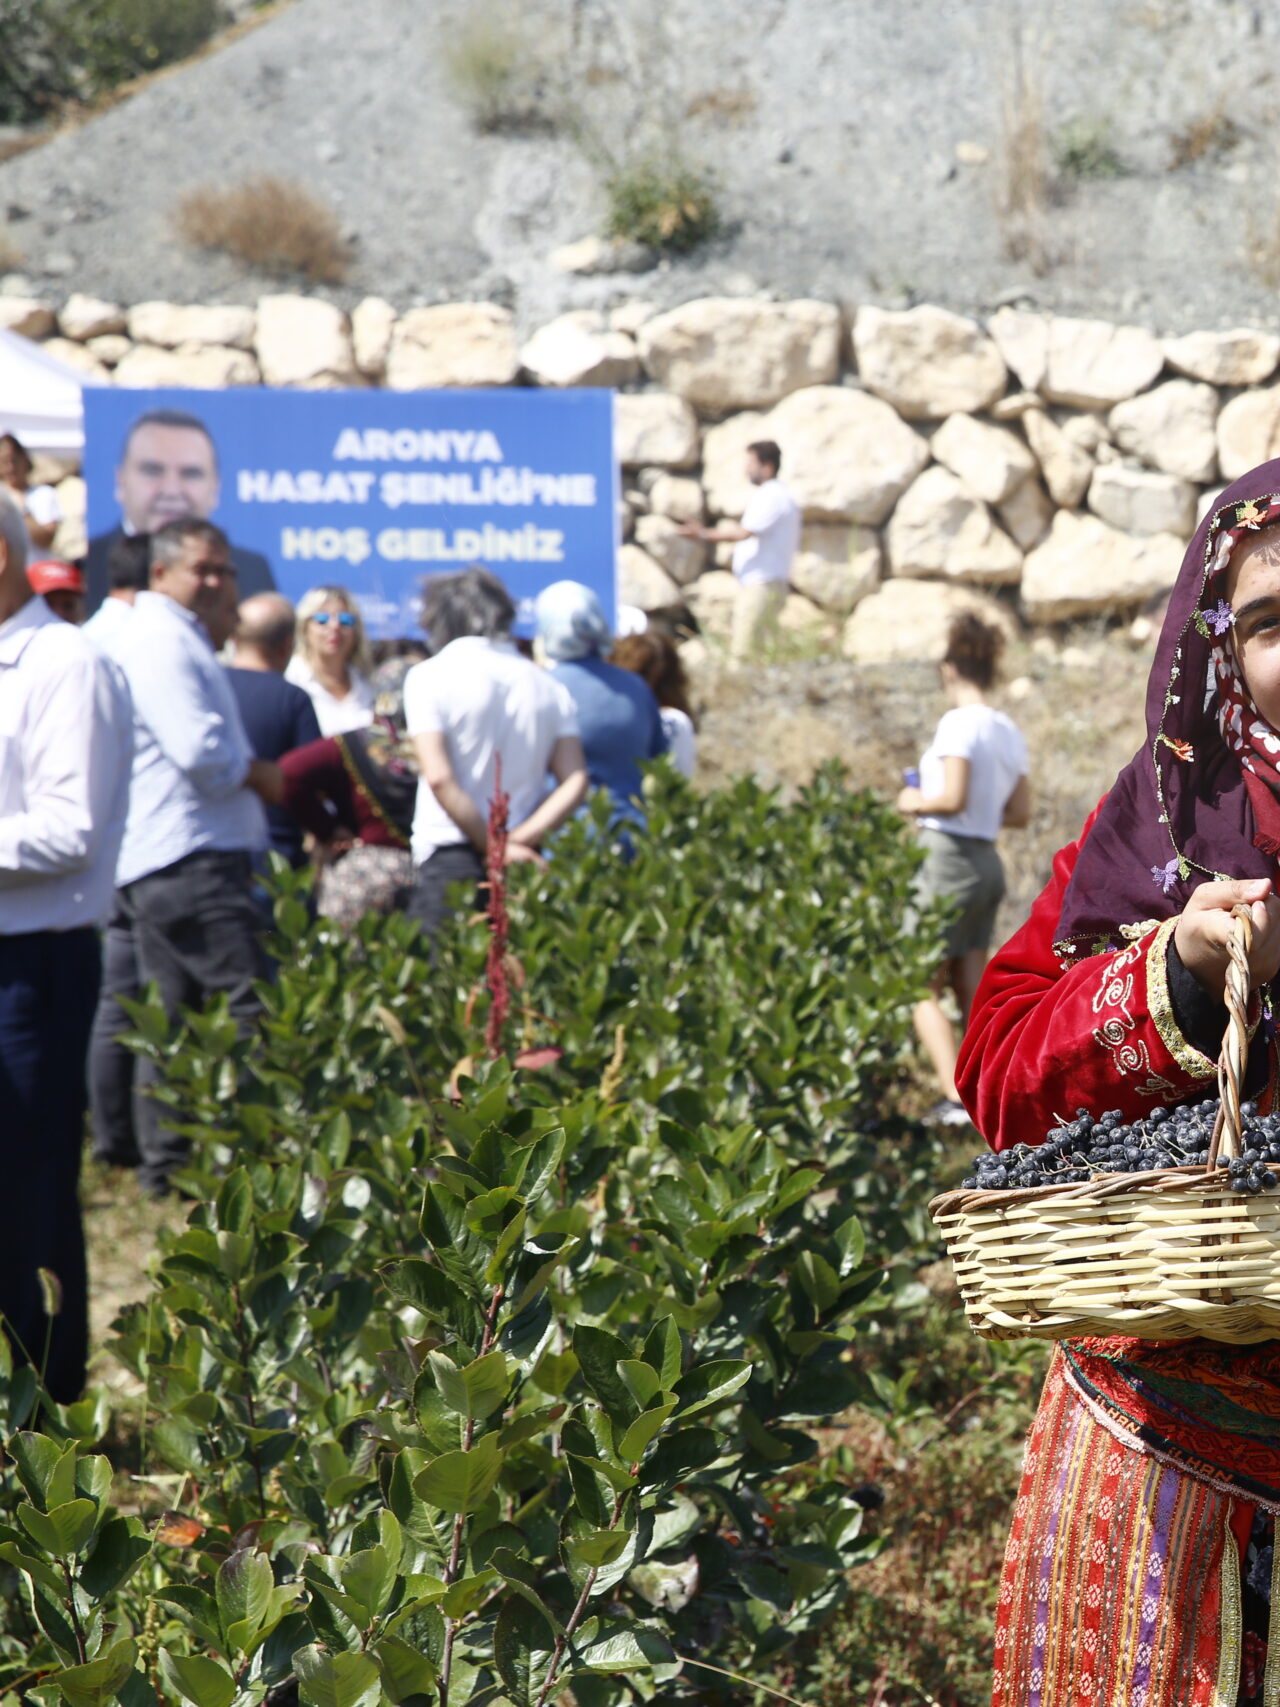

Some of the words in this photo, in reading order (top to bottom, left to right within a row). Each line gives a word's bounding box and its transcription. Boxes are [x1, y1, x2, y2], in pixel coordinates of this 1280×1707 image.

[334, 430, 502, 461] ARONYA
[239, 472, 375, 502] HASAT
[381, 468, 595, 507] ŞENLİĞİ'NE
[283, 529, 369, 564] HOŞ
[379, 524, 563, 561] GELDİNİZ
